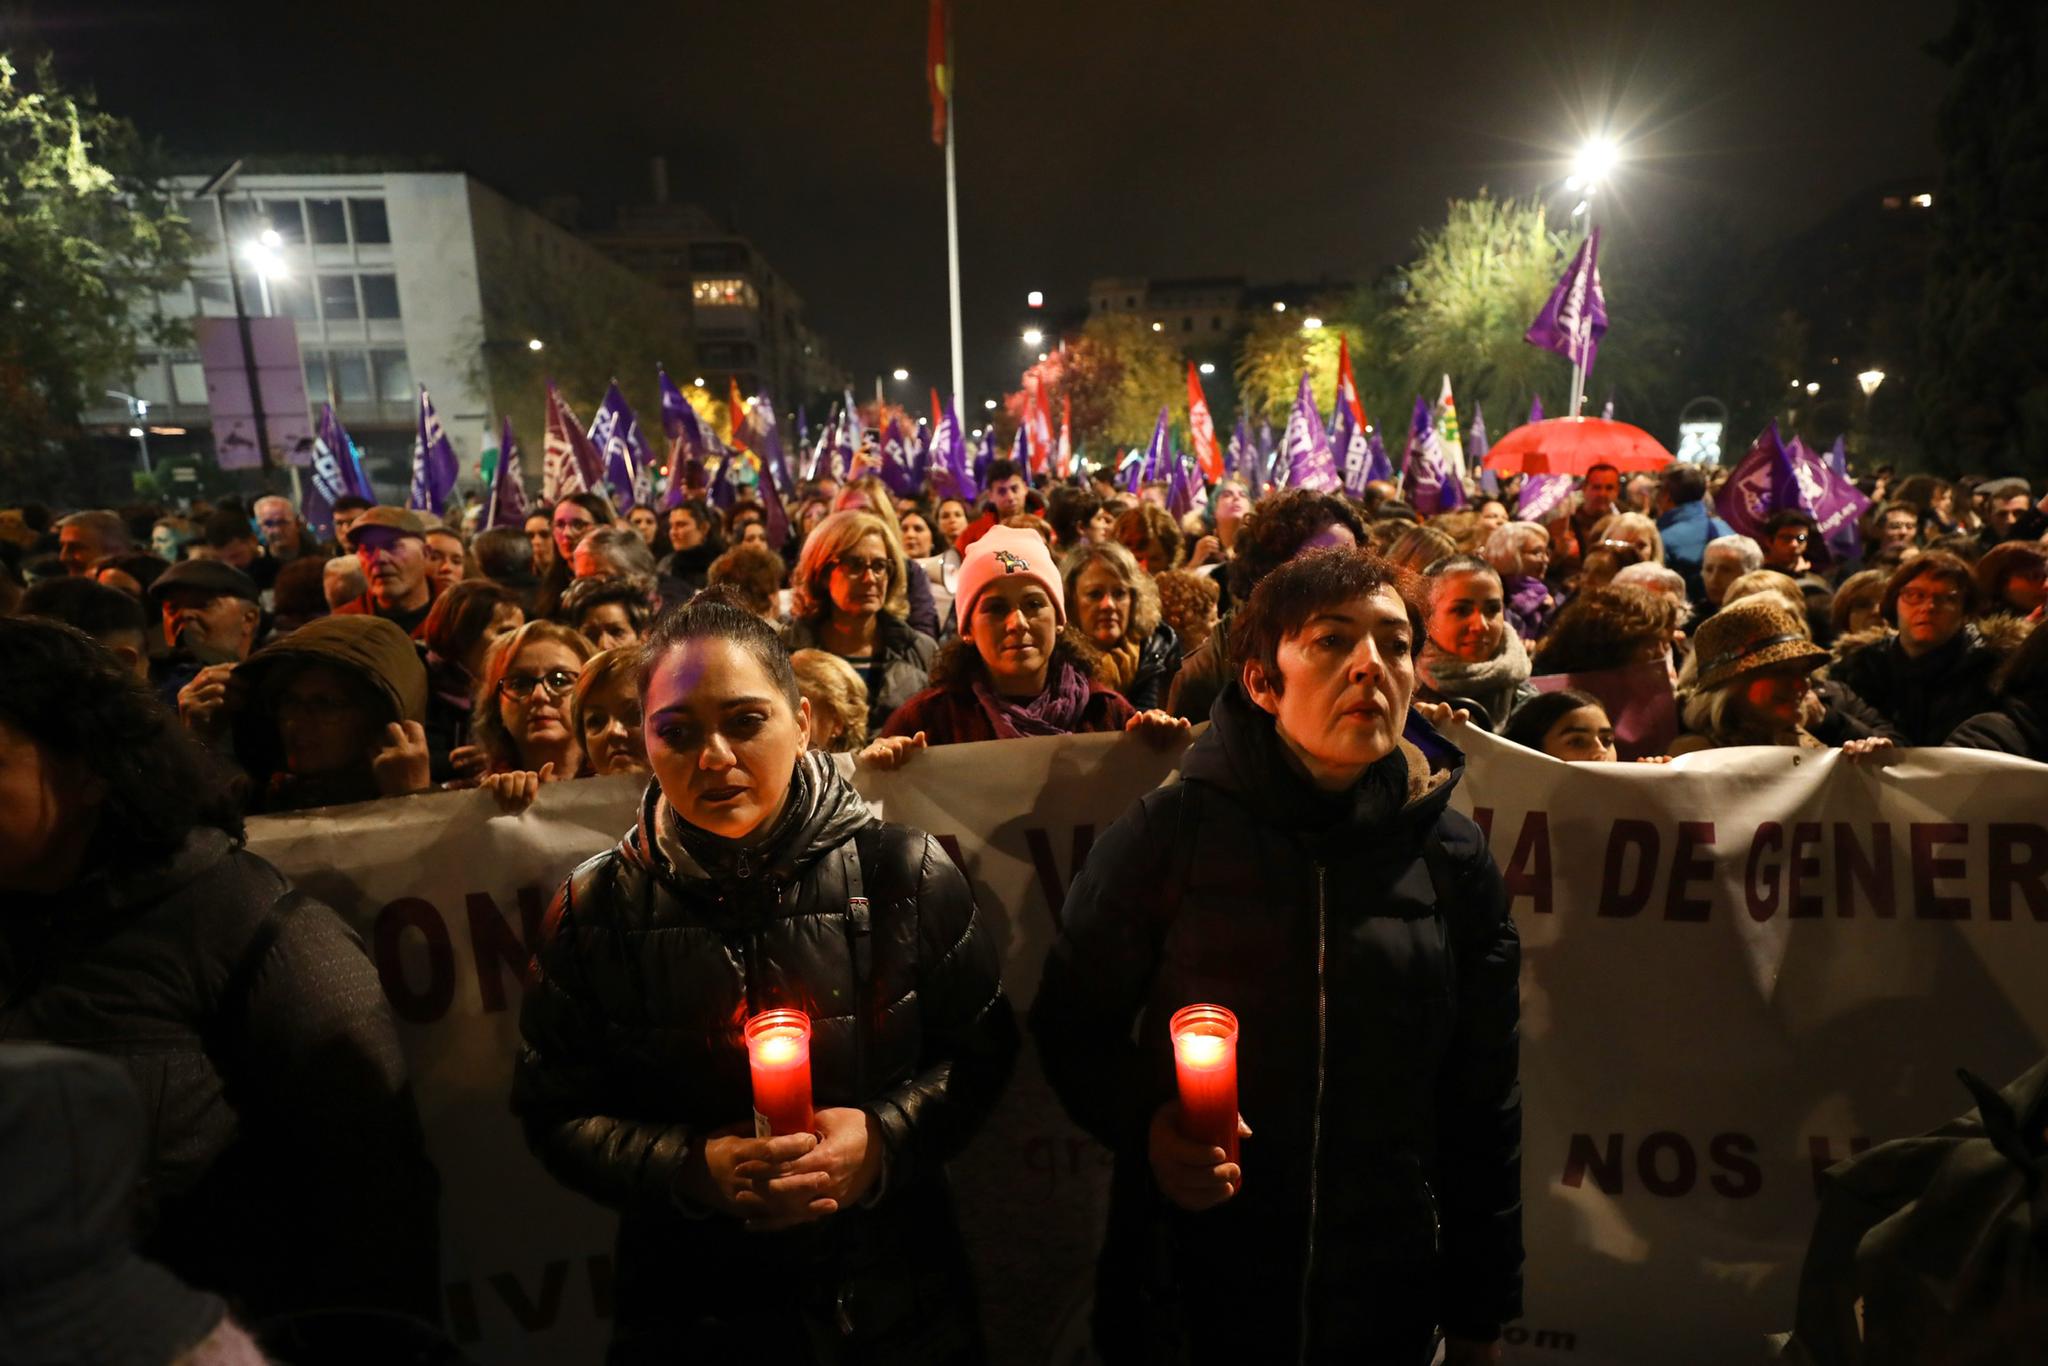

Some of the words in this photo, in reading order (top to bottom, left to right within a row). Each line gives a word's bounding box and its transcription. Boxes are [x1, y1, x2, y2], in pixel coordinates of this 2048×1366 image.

[374, 886, 544, 1024] ON
[1598, 818, 1717, 922] DE
[1745, 821, 2048, 922] GENER
[1562, 1132, 1763, 1199] NOS
[1503, 1327, 1577, 1352] om
